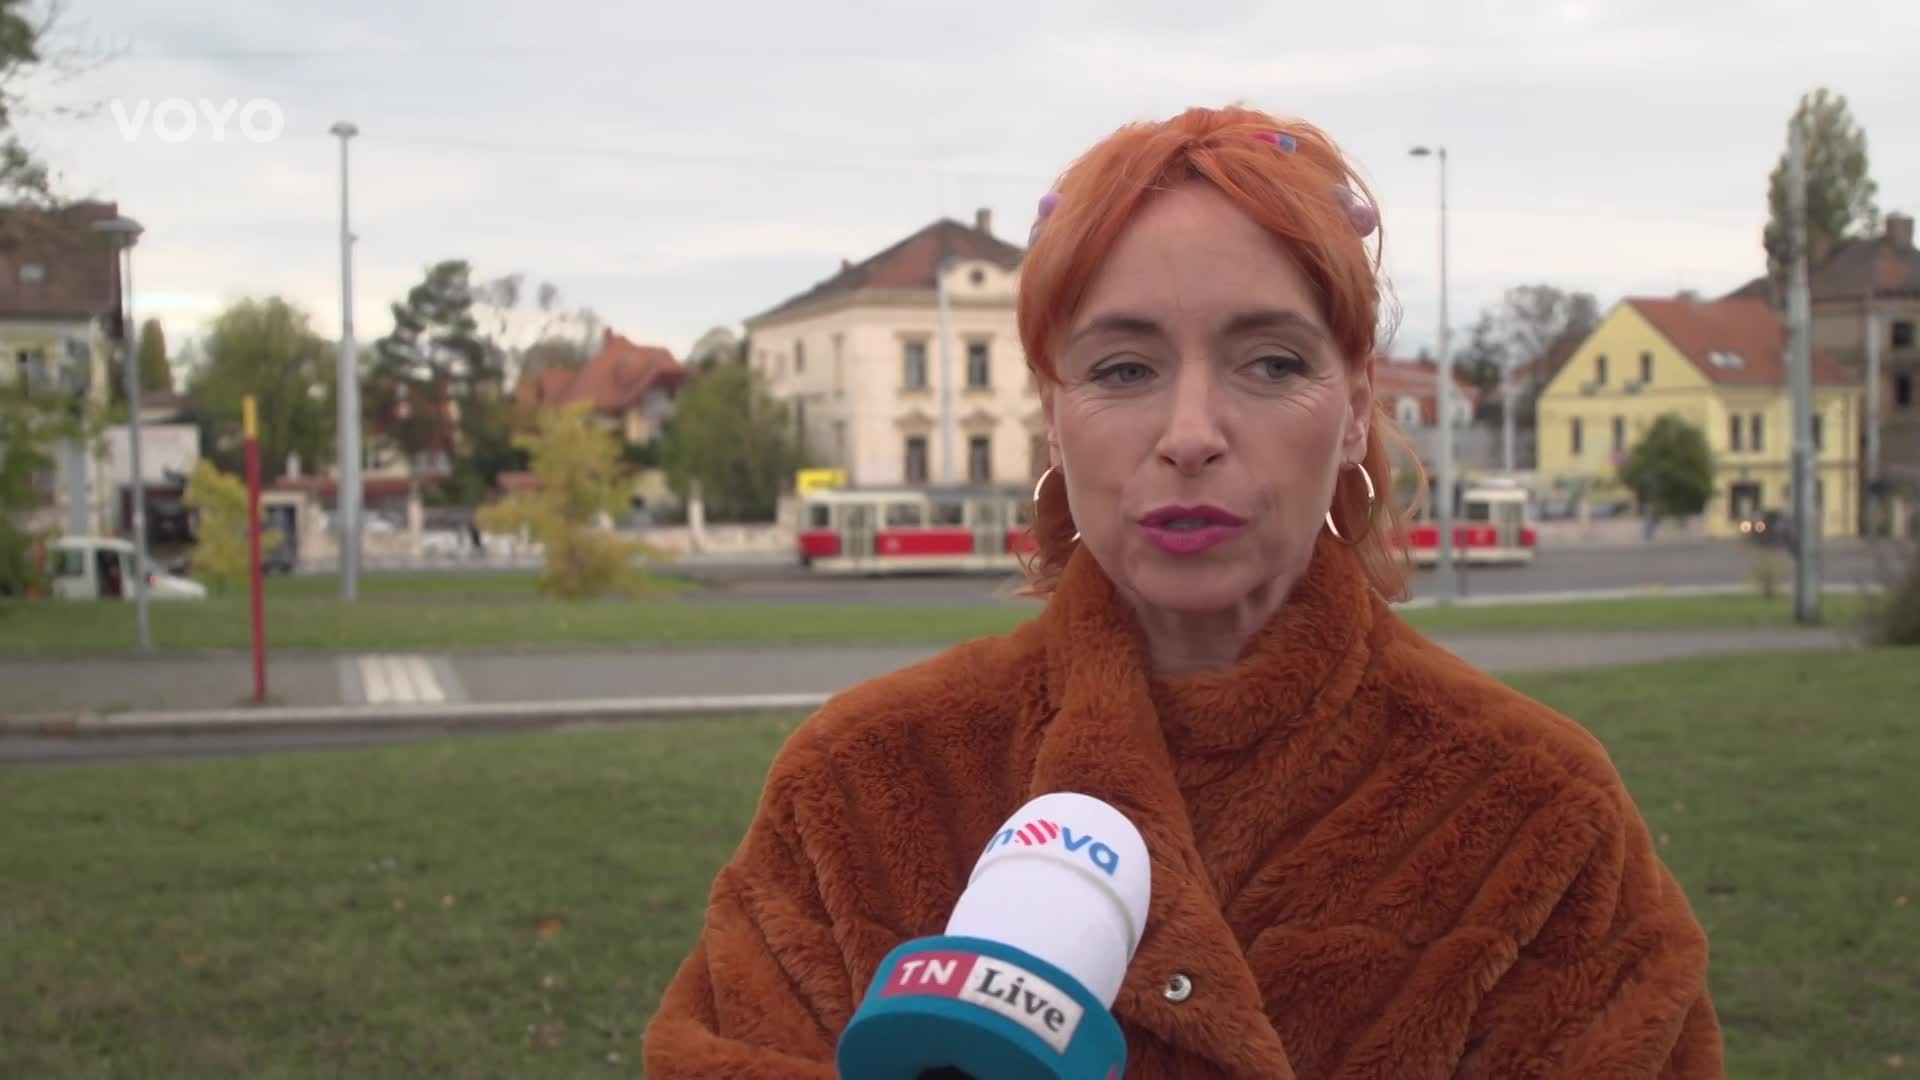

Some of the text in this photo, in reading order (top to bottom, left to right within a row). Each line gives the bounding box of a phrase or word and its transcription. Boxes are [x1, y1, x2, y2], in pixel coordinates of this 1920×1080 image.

[987, 819, 1119, 876] nova
[900, 959, 1066, 1032] TN Live
